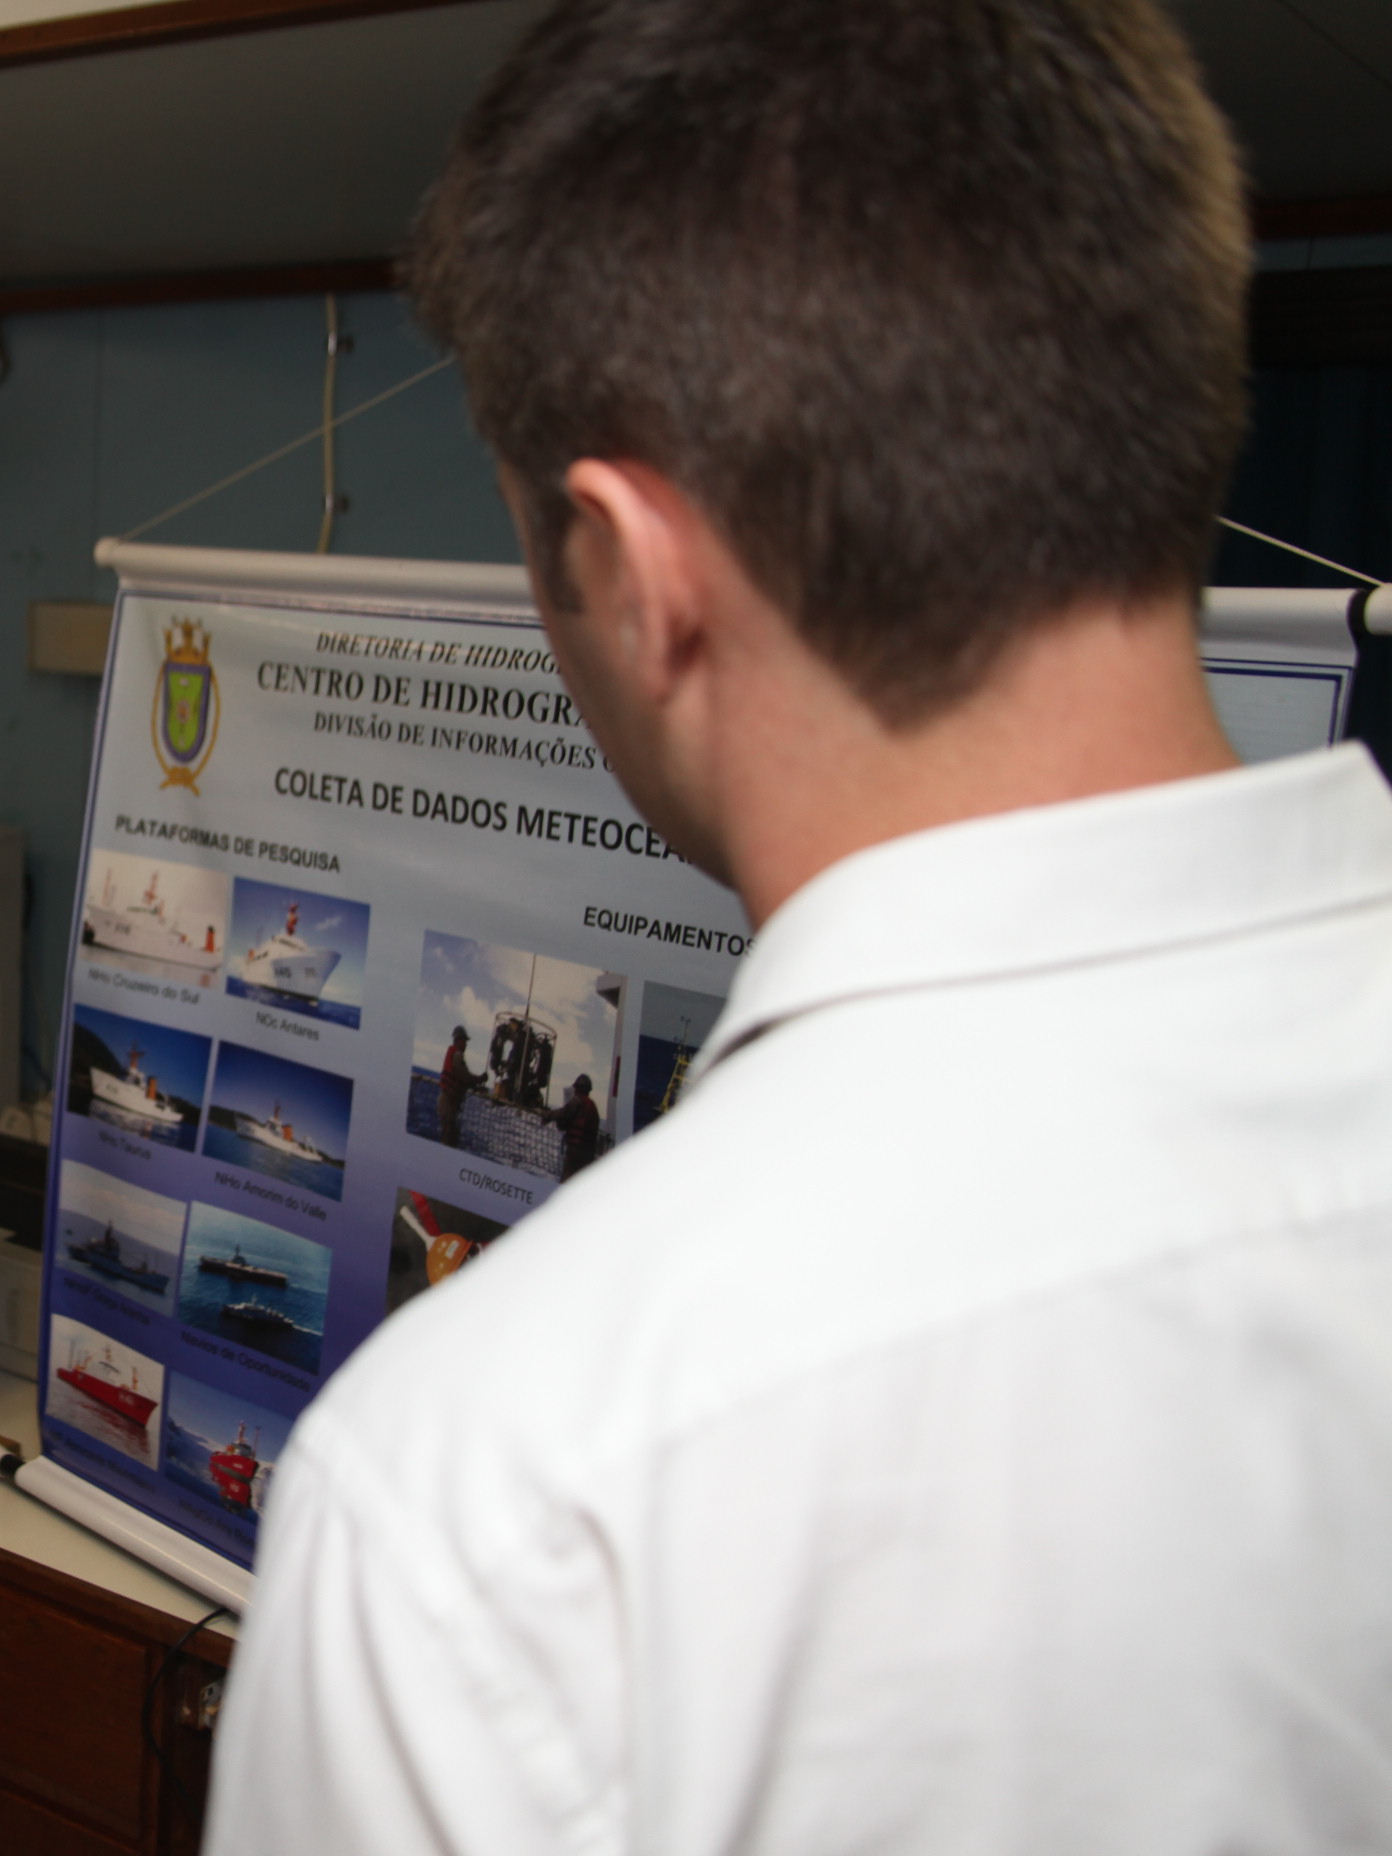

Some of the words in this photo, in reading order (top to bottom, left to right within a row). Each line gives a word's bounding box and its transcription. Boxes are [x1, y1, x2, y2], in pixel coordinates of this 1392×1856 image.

[316, 631, 426, 662] DIRETORIA
[428, 640, 460, 665] DE
[463, 643, 561, 675] HIDROG
[257, 660, 364, 700] CENTRO
[372, 673, 411, 707] DE
[419, 678, 584, 727] HIDROGR
[313, 711, 391, 741] DIVISÃO
[397, 722, 425, 746] DE
[431, 726, 596, 769] INFORMAÇÕES
[274, 766, 365, 808] COLETA
[371, 781, 404, 815] DE
[411, 788, 508, 832] DADOS
[516, 805, 692, 864] METEOCE
[114, 814, 229, 852] PLATAFORMAS
[234, 836, 255, 857] DE
[258, 840, 341, 873] PESQUISA
[112, 971, 159, 996] Cruzeiro
[162, 985, 178, 1000] do
[180, 989, 200, 1006] Sul
[279, 1015, 320, 1041] Antares
[459, 1168, 533, 1204] CTD/ROSETTE
